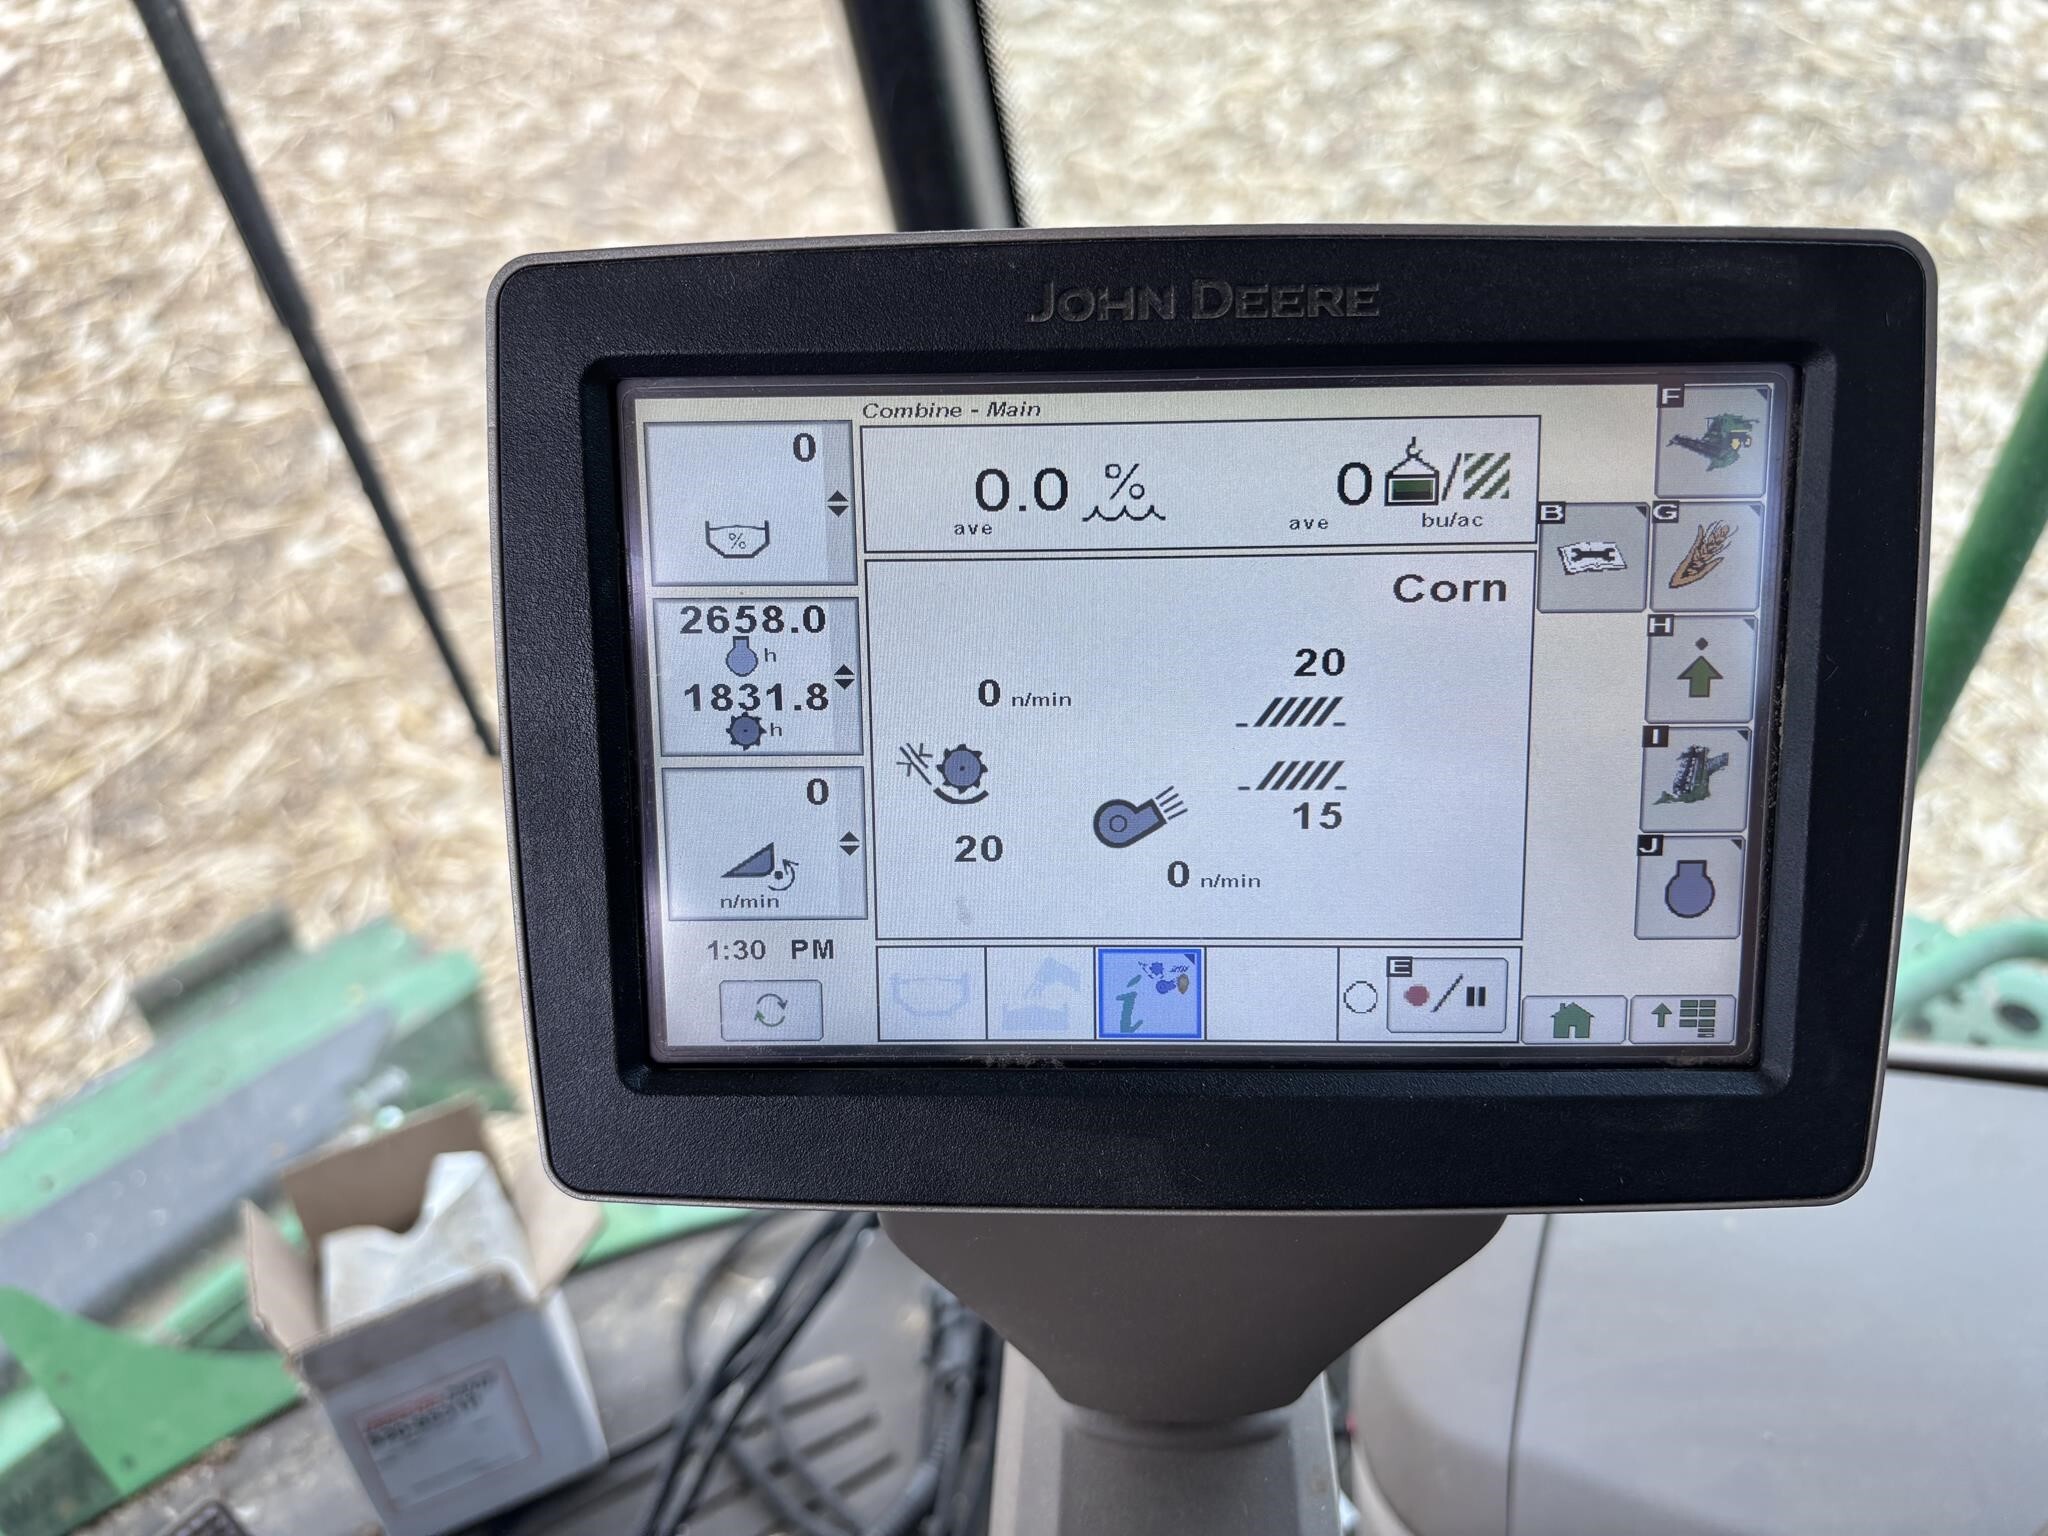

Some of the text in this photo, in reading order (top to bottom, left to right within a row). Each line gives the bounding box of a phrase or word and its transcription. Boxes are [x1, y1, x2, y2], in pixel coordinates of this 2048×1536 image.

[1027, 277, 1380, 323] JOHN DEERE
[1662, 388, 1681, 404] F
[862, 401, 962, 420] Combine
[986, 400, 1042, 418] Main
[792, 432, 817, 462] 0
[975, 467, 1069, 512] 0.0
[1336, 461, 1374, 506] 0
[1288, 516, 1330, 531] ave
[1421, 512, 1484, 528] bu/ac
[1540, 504, 1564, 521] B
[1652, 503, 1679, 521] G
[953, 522, 993, 537] ave
[1393, 573, 1508, 603] Corn
[680, 604, 827, 634] 2658.0
[1648, 618, 1671, 634] H
[763, 648, 777, 663] h
[1293, 647, 1346, 677] 20
[684, 683, 829, 712] 1831.8
[978, 679, 1073, 708] 0 n/min
[769, 722, 783, 738] h
[806, 778, 830, 805] 0
[1292, 801, 1343, 830] 15
[955, 835, 1004, 862] 20
[1638, 837, 1660, 853] J
[1167, 861, 1262, 889] 0 n/min
[720, 893, 781, 910] n/min
[706, 938, 836, 961] 1:30 PM
[1391, 959, 1412, 975] E
